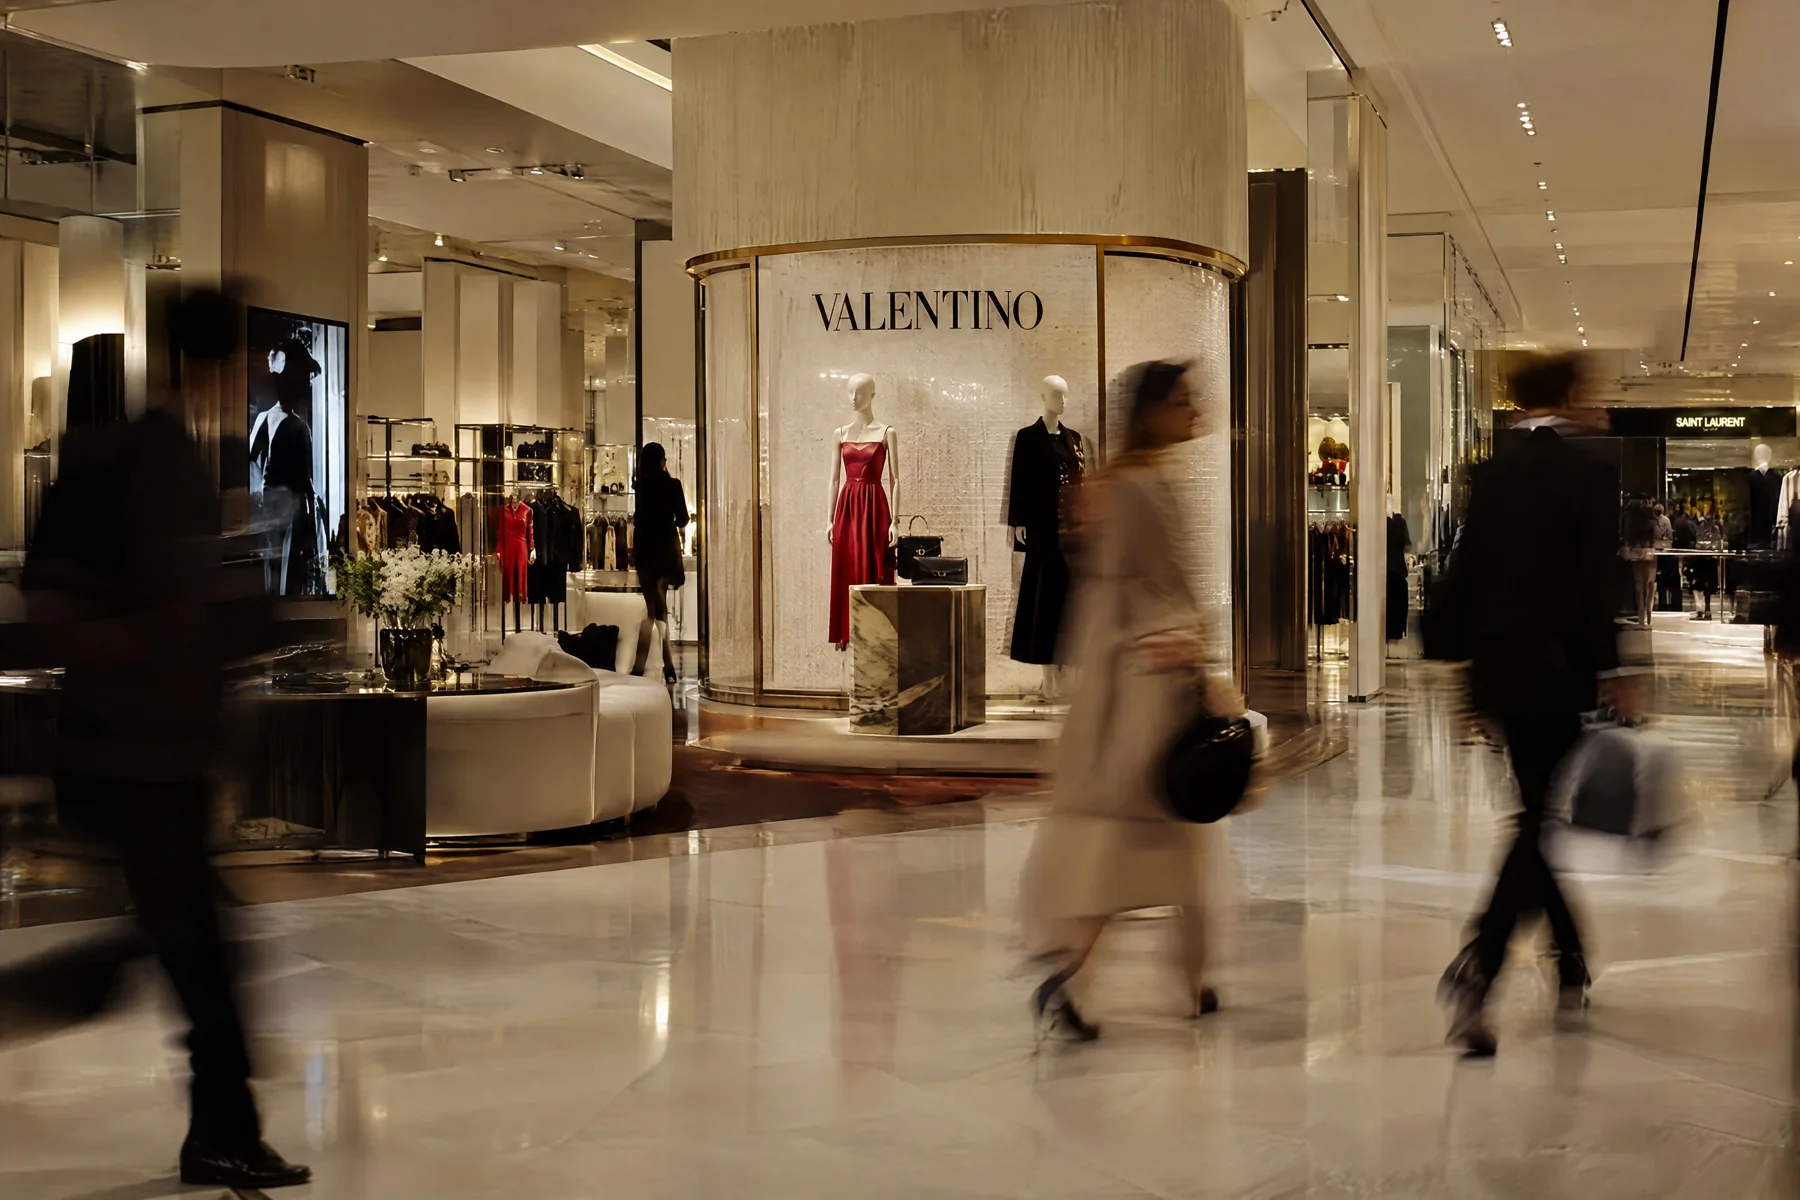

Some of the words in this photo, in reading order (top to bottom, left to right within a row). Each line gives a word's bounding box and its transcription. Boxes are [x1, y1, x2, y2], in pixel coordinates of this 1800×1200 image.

[812, 290, 1044, 332] VALENTINO
[1676, 417, 1703, 427] SAINT
[1704, 417, 1745, 427] LAURENT
